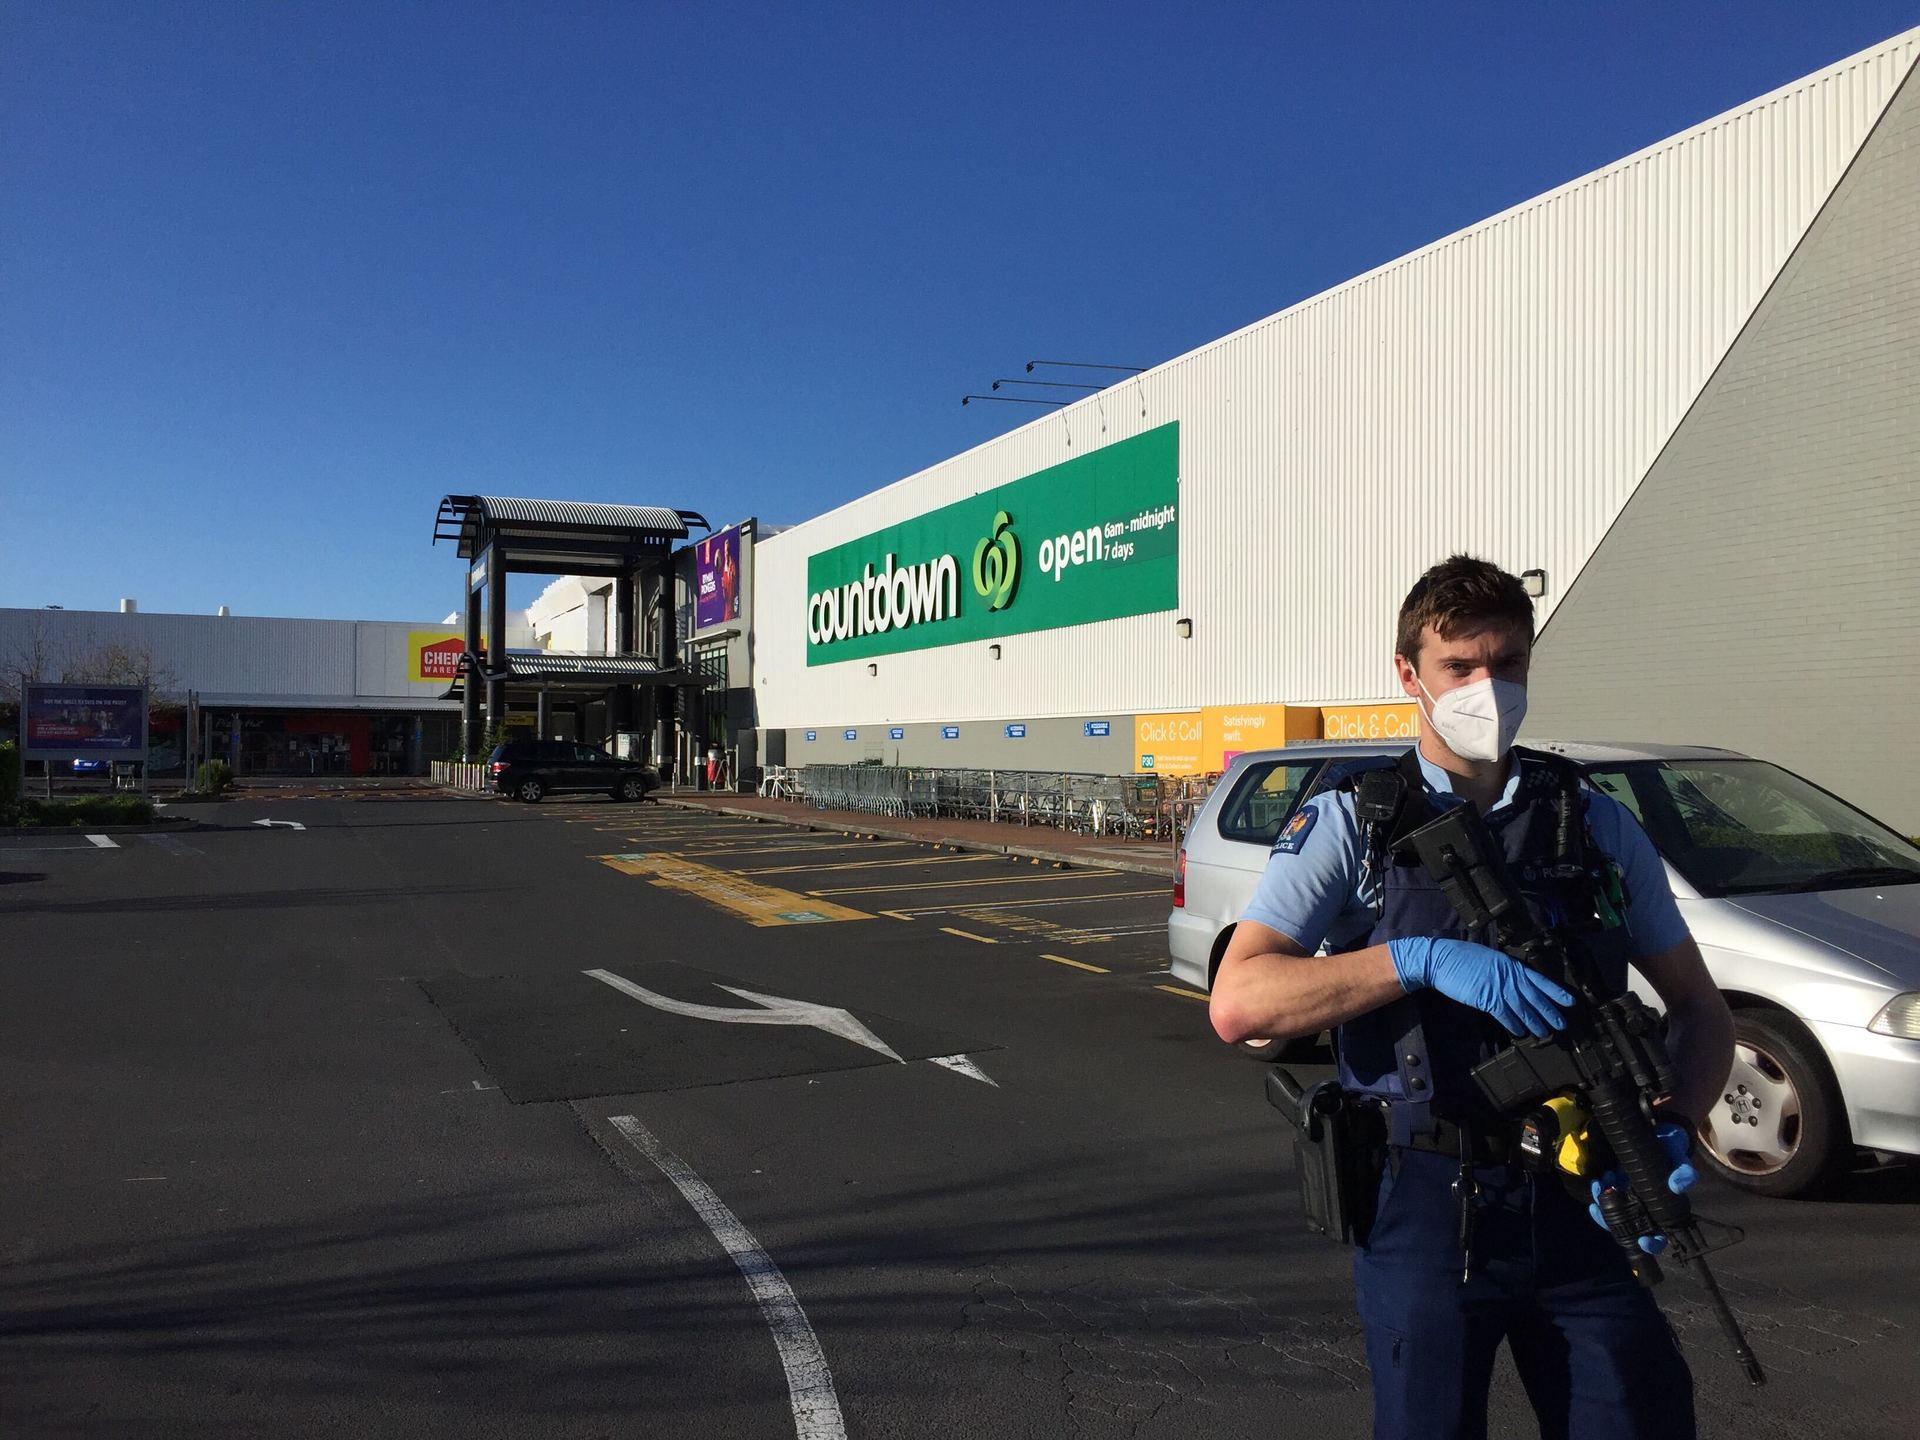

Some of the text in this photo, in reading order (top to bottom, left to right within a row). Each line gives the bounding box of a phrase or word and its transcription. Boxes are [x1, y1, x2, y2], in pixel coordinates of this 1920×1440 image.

[1104, 522, 1124, 539] 6am
[1130, 505, 1175, 532] midnight
[1038, 526, 1102, 582] open
[1104, 541, 1134, 561] 7 days
[808, 553, 957, 644] countdown
[424, 651, 464, 666] CHEM
[424, 665, 458, 674] WARE
[1141, 720, 1201, 741] Click & Coll
[1222, 714, 1265, 728] Satisfyingly
[1327, 715, 1366, 738] Click
[1369, 713, 1380, 738] &
[1384, 713, 1421, 738] Coll
[1142, 756, 1154, 767] P30
